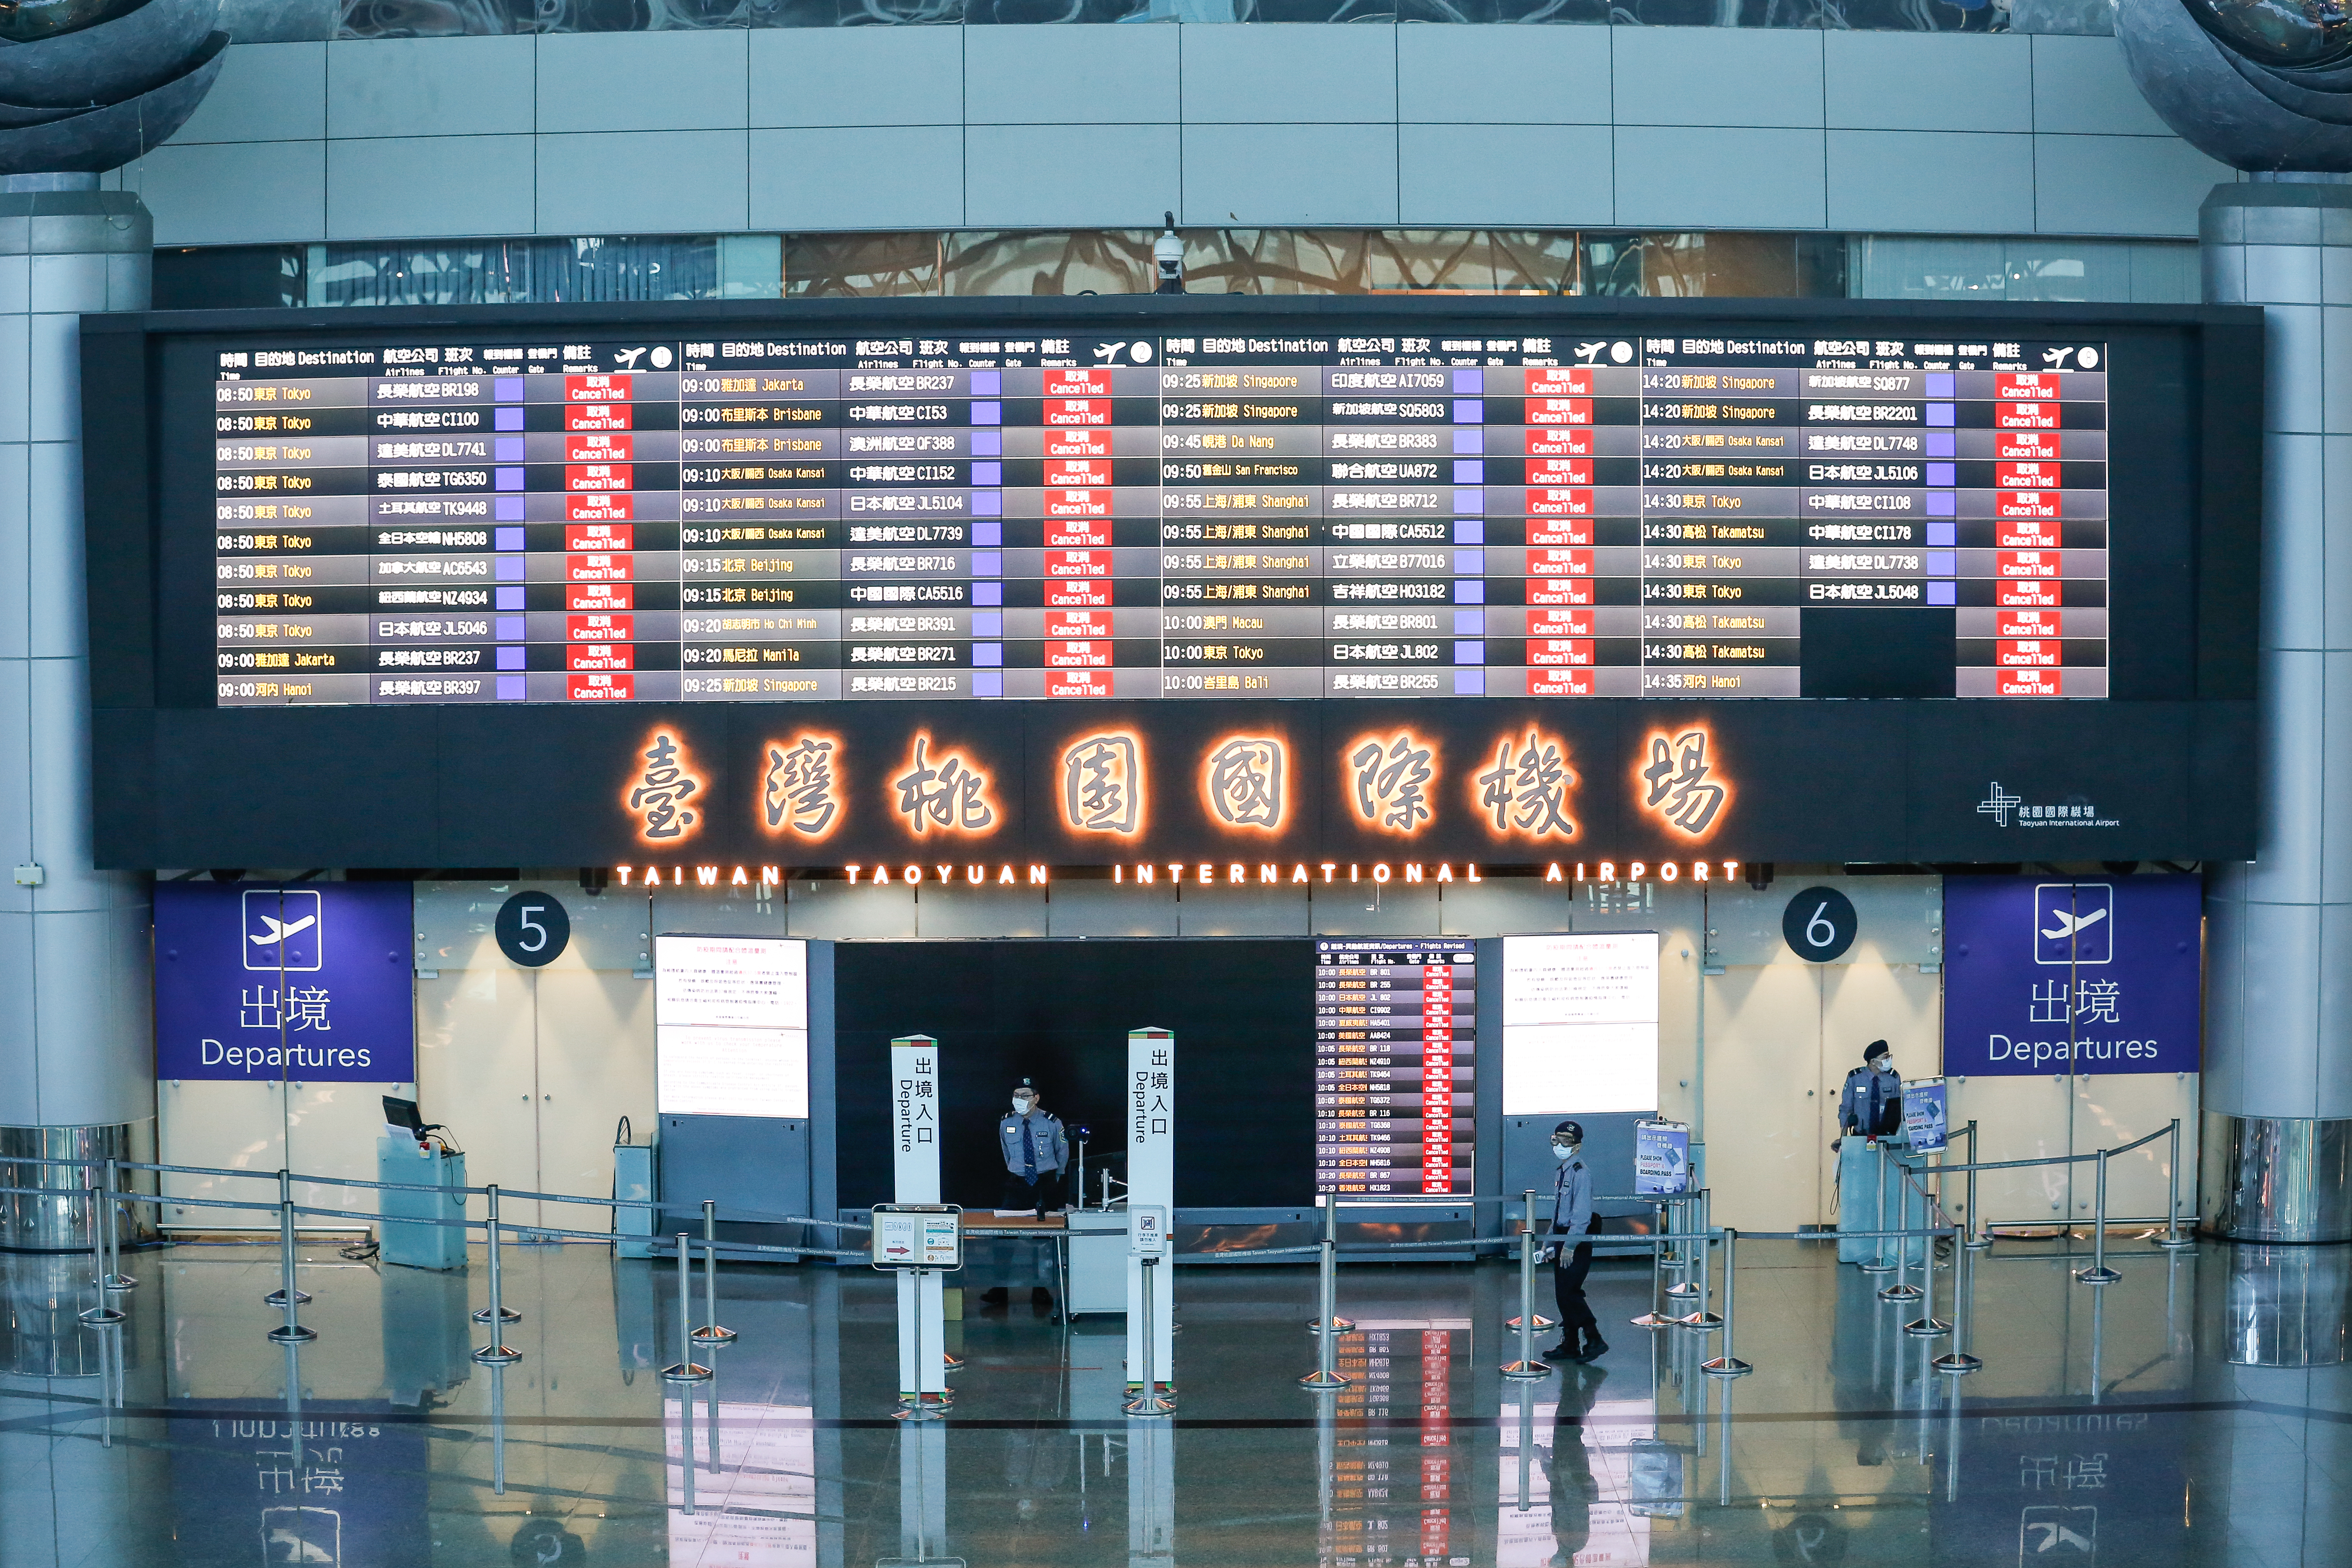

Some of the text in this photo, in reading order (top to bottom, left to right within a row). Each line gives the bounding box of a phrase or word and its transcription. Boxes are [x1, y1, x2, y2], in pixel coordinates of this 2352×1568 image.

[220, 352, 248, 367] 時間
[254, 351, 296, 366] 目的地
[298, 350, 374, 366] Destination
[383, 348, 438, 363] 航空公司
[444, 347, 473, 363] 班次
[563, 344, 592, 360] 備註
[220, 364, 598, 381] Time Airlines Flight No. Counter Gate Remarks
[1547, 370, 1570, 381] 取消
[586, 376, 610, 388] 取消
[1162, 373, 1445, 390] 09:25 新加坡 Singapore 印度航空 AI7059
[1532, 382, 1585, 394] Cancelled
[216, 382, 479, 402] 08:50 東京 Tokyo 長榮航空 BR198
[572, 388, 624, 400] Cancelled
[1065, 400, 1089, 412] 取消
[682, 405, 947, 423] 09:00 布里斯本 Brisbane 中華航空 CI53
[1051, 413, 1104, 424] Cancelled
[1644, 494, 1911, 510] 14:30 東京 Tokyo 中華航空 CI108
[2017, 493, 2039, 505] 取消
[2003, 505, 2053, 516] Cancelled
[683, 585, 963, 603] 09:15 北京 Beijing 中國國際 CA5516
[1066, 581, 1090, 594] 取消
[1051, 594, 1105, 606] Cancelled
[587, 644, 611, 657] 取消
[1164, 645, 1438, 660] 10:00 東京 Tokyo 日本航空 JL802
[1548, 640, 1571, 652] 取消
[1644, 644, 1765, 659] 14:30 高松 Takamatsu
[2017, 641, 2040, 653] 取消
[218, 651, 481, 668] 09:00 雅加達 Jakarta 長榮航空 BR237
[574, 657, 625, 669] Cancelled
[1533, 653, 1586, 665] Cancelled
[2003, 653, 2054, 665] Cancelled
[2019, 806, 2094, 818] 桃園國際機場
[617, 861, 1739, 886] TAIWAN TAOYUAN INTERNATIONAL AIRPORT
[519, 906, 547, 952] 5
[1806, 902, 1835, 947] 6
[240, 984, 331, 1031] 出境
[2029, 978, 2120, 1024] 出境
[201, 1038, 371, 1073] Departures
[1989, 1034, 2157, 1068] Departures
[1151, 1049, 1168, 1135] 出境入口
[915, 1057, 933, 1143] 出境入口
[1132, 1071, 1148, 1143] Departure
[897, 1080, 912, 1152] Departure
